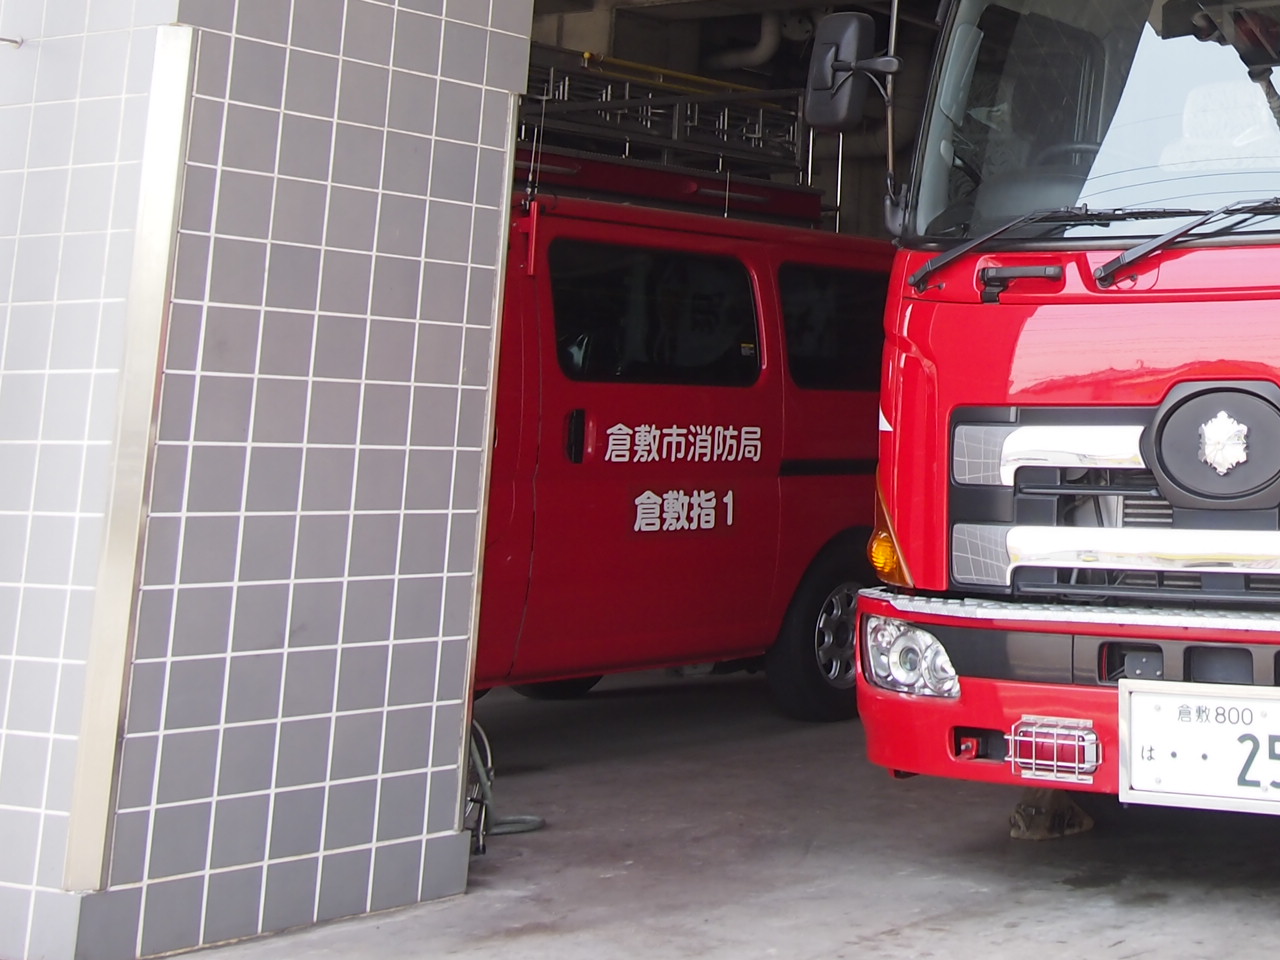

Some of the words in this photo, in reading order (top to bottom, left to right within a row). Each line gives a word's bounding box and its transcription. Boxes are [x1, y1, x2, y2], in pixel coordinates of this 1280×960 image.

[604, 423, 762, 463] 倉敷市消防局
